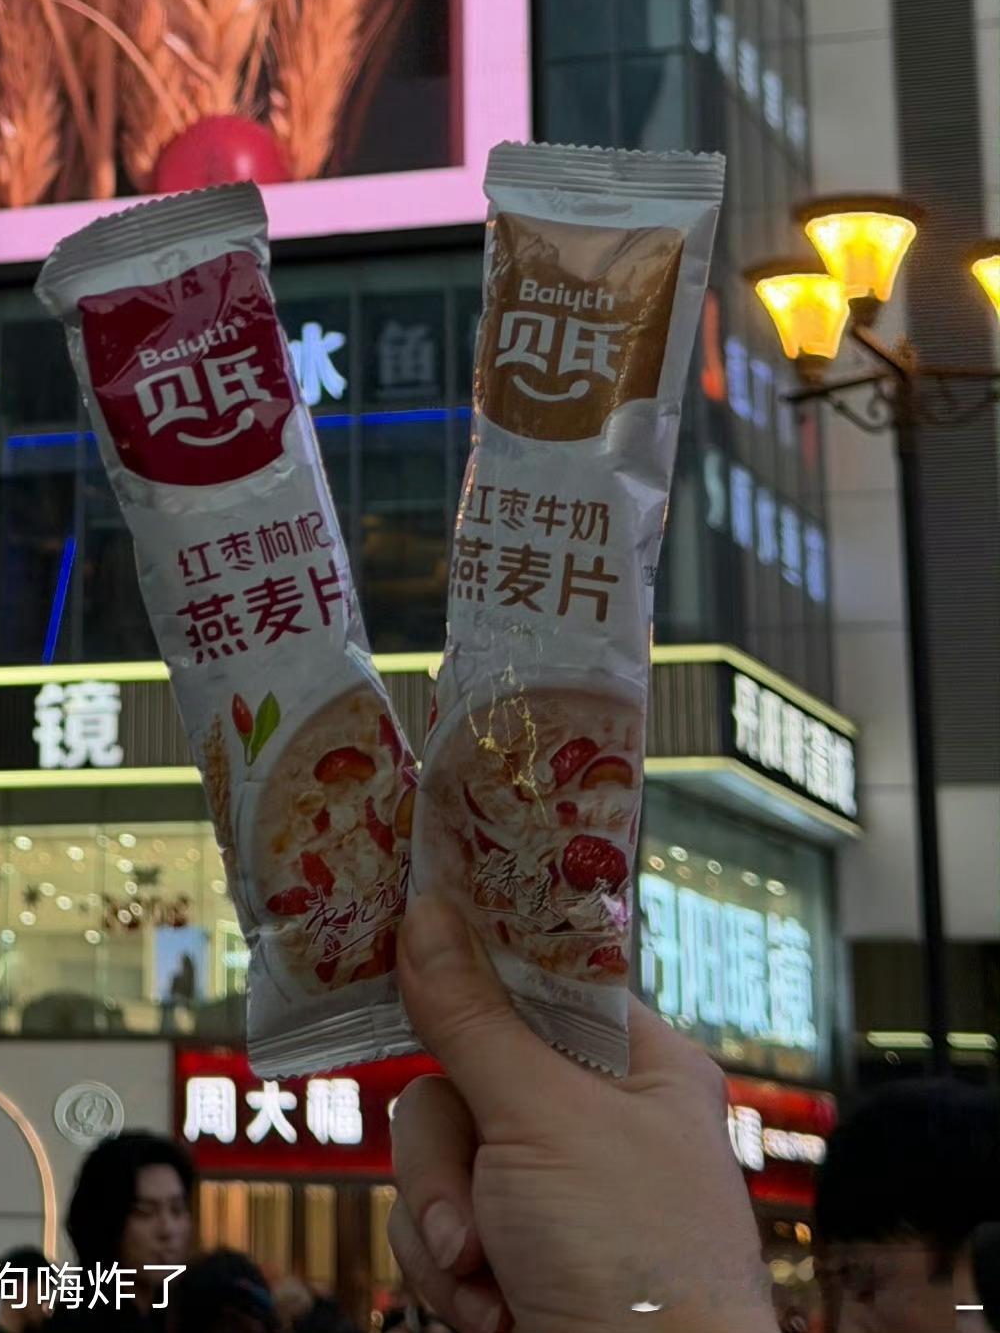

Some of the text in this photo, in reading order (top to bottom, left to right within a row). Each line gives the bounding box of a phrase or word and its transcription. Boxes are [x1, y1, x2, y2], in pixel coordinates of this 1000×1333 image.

[520, 279, 615, 312] Baiyth
[495, 310, 628, 383] 贝氏
[134, 345, 272, 438] 贝氏
[178, 512, 332, 587] 红枣枸杞
[466, 484, 611, 546] 红枣牛奶
[176, 559, 346, 665] 燕麦片
[450, 533, 620, 623] 燕麦片
[184, 1077, 364, 1146] 周大福
